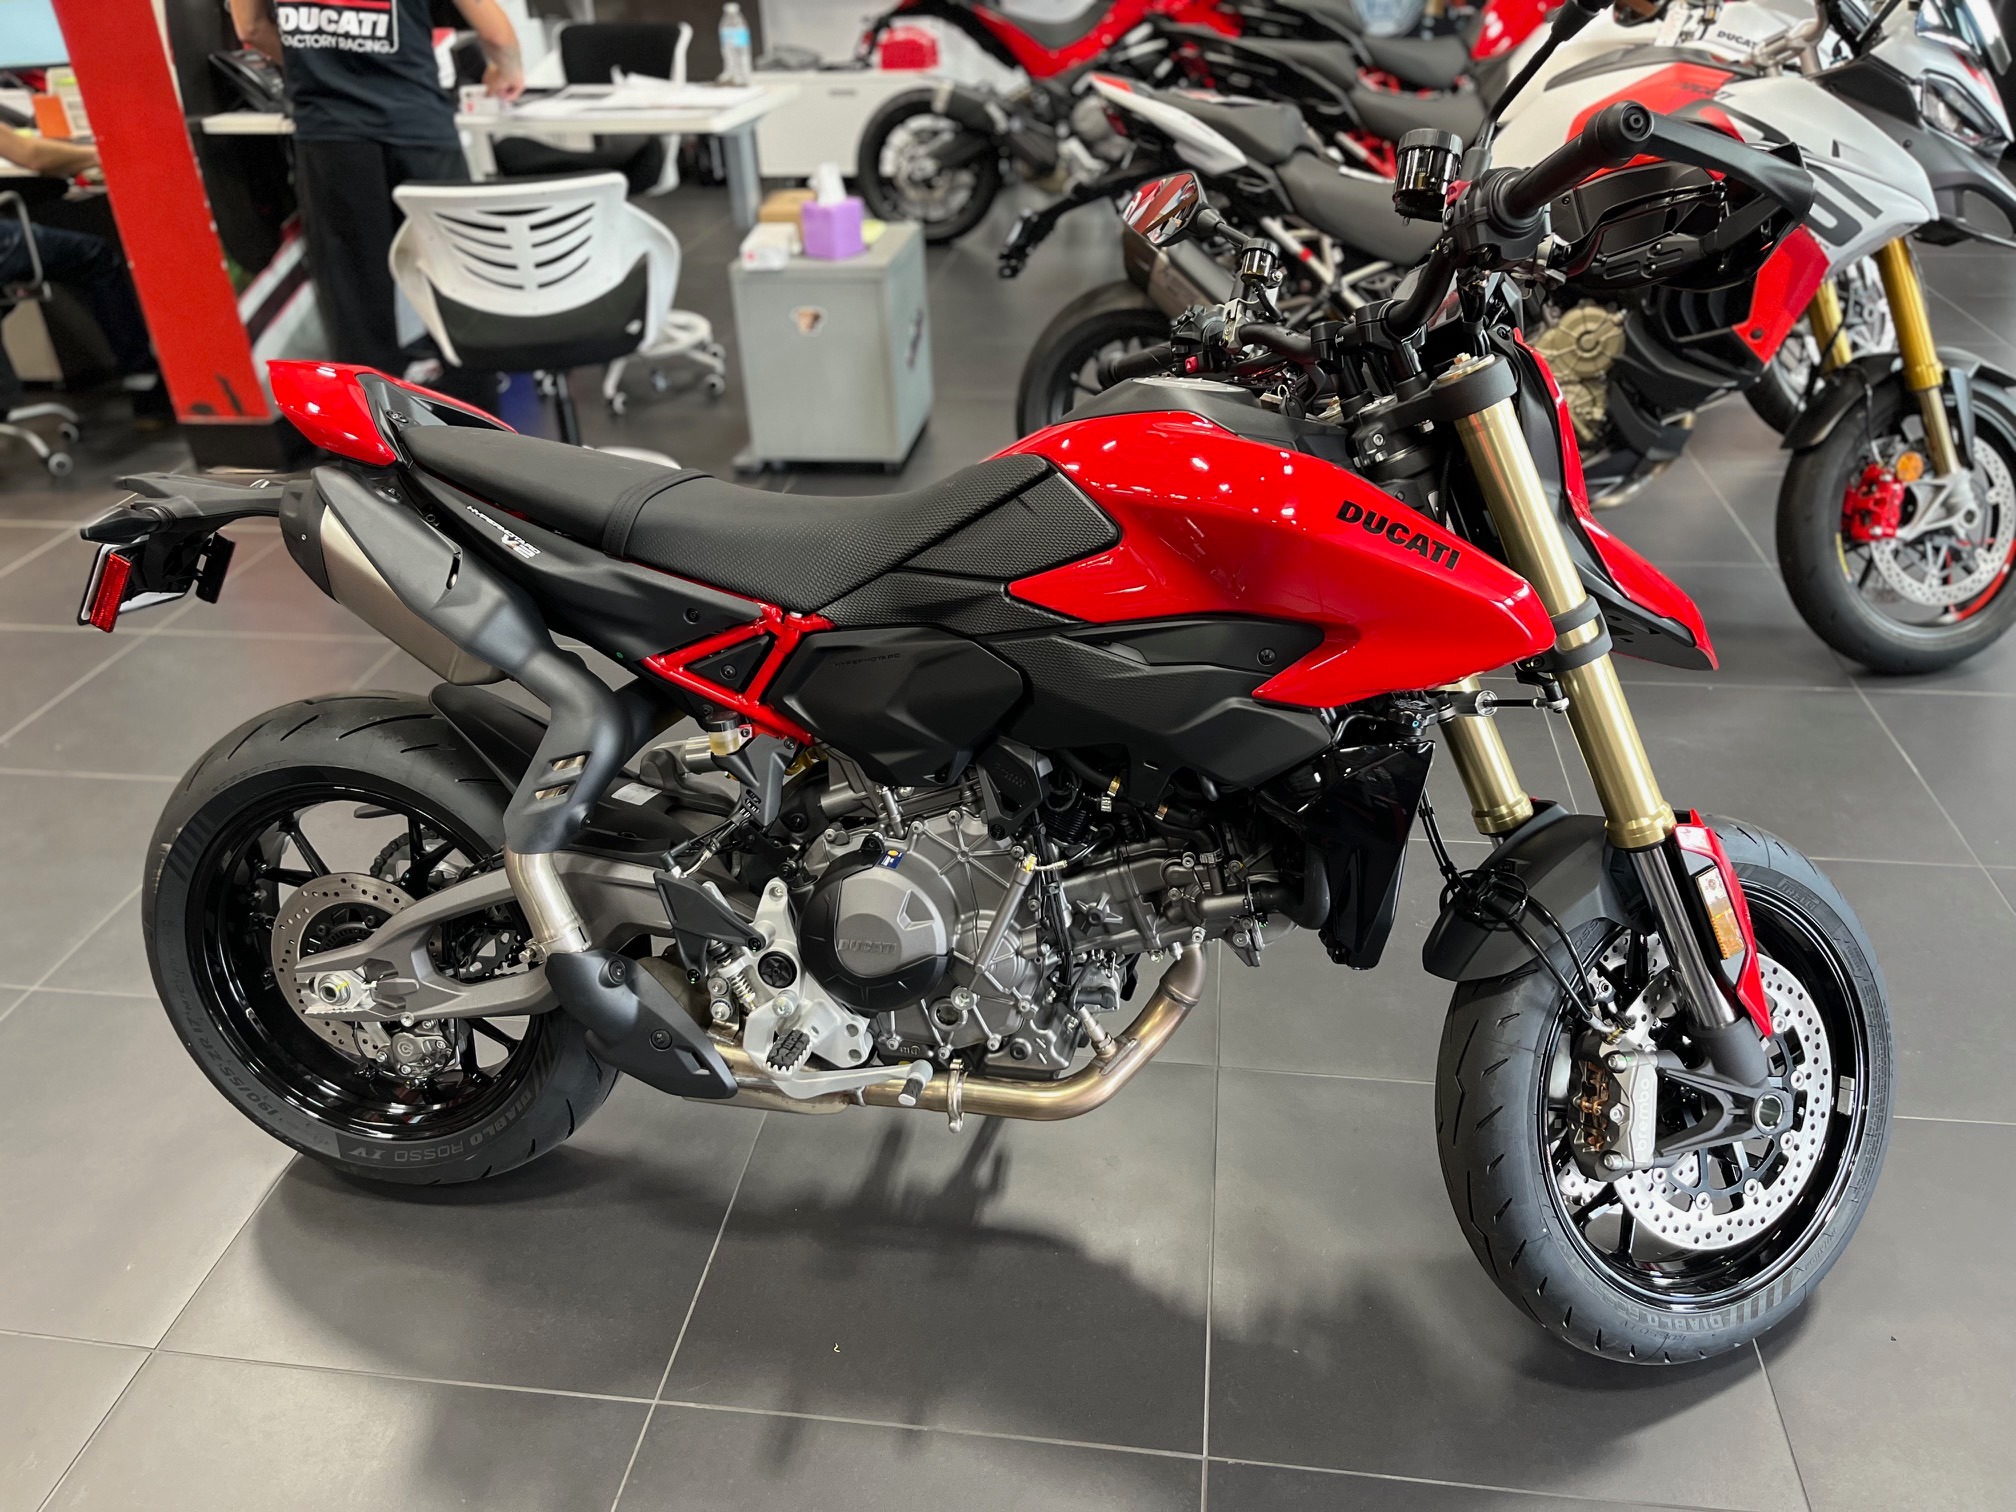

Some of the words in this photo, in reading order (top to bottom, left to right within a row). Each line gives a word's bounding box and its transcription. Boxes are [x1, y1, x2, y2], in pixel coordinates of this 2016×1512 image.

[277, 6, 390, 38] DUCATI
[338, 38, 392, 54] RACING
[1717, 30, 1757, 49] DUCAT
[1336, 500, 1460, 570] DUCATI
[1776, 877, 1820, 911] PIRELLI
[837, 938, 897, 955] DUCATI
[217, 1062, 280, 1118] 190/55
[468, 1089, 533, 1147] DIABLO
[1634, 1077, 1650, 1153] brembo
[393, 1139, 464, 1163] ROSSO
[1647, 1311, 1725, 1333] DIABLO
